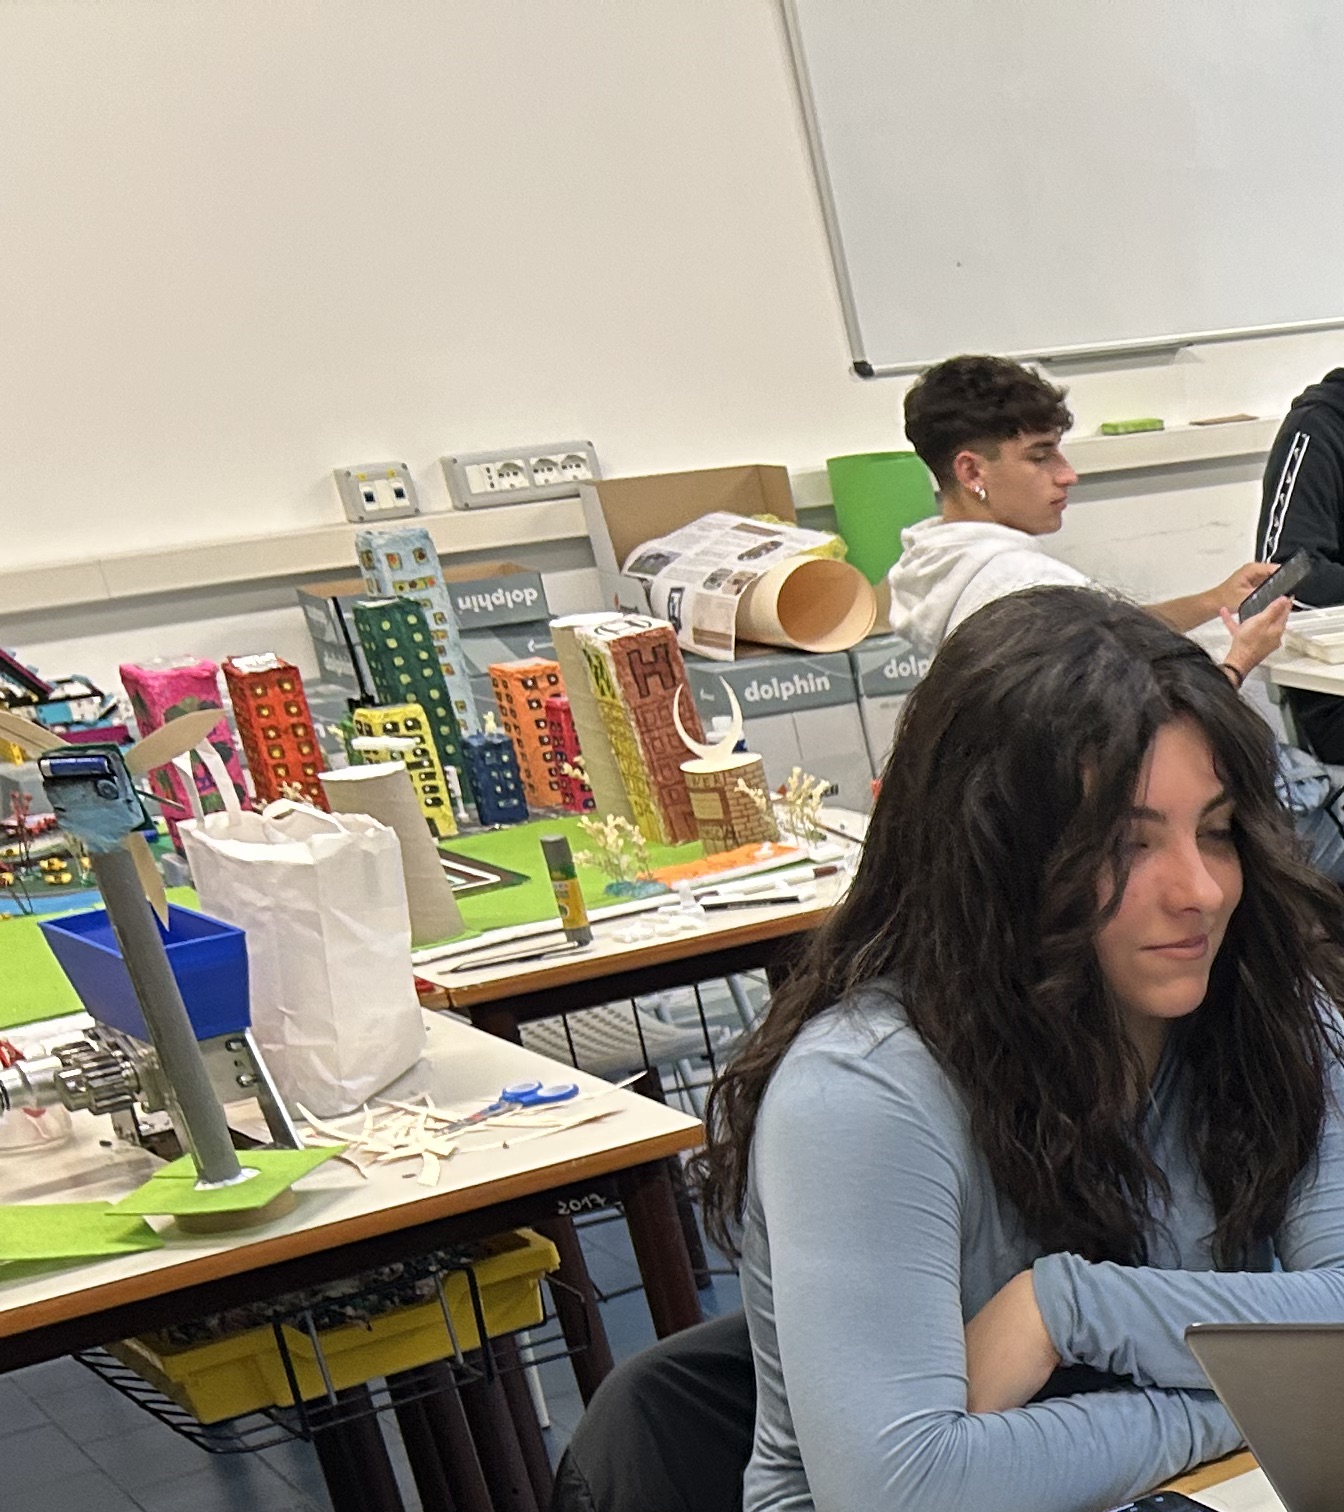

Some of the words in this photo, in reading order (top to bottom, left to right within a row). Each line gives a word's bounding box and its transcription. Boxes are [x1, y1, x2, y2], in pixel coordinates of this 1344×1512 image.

[458, 587, 538, 614] dolphin
[627, 643, 676, 699] H
[744, 673, 831, 702] dolphin
